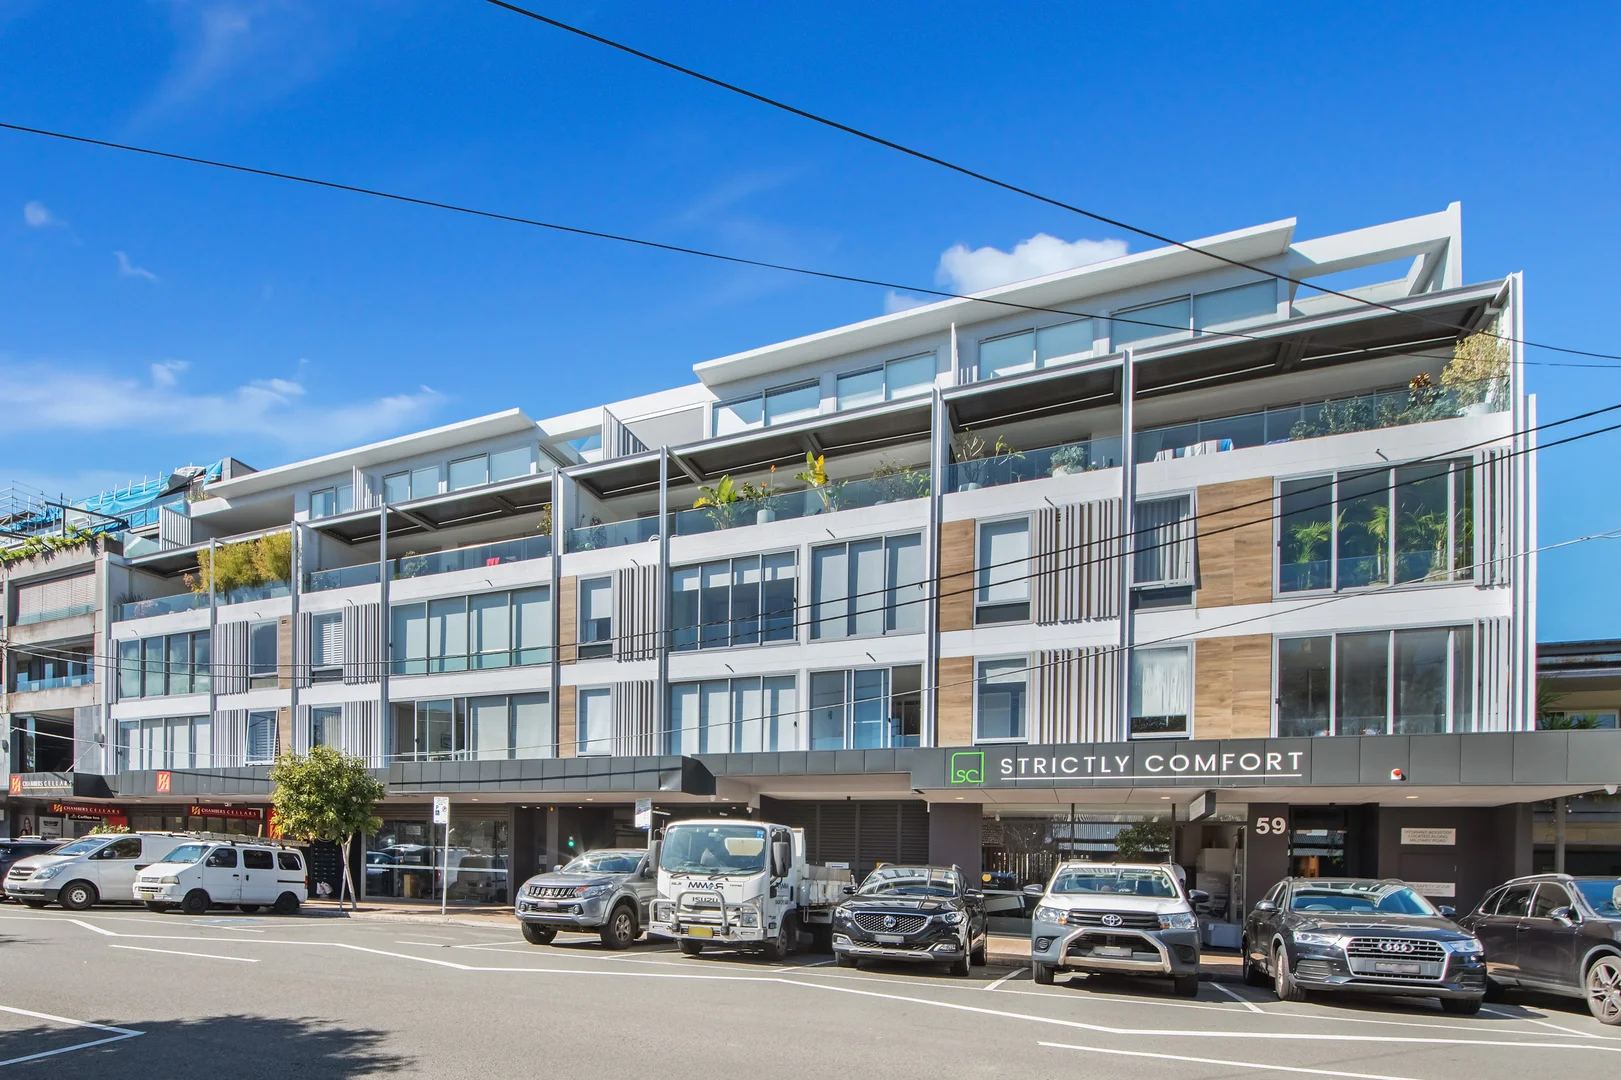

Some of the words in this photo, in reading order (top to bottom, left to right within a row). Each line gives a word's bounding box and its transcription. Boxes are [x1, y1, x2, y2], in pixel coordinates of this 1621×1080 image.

[1000, 756, 1130, 775] STRICTLY
[1145, 752, 1303, 772] COMFORT
[1255, 817, 1286, 835] 59
